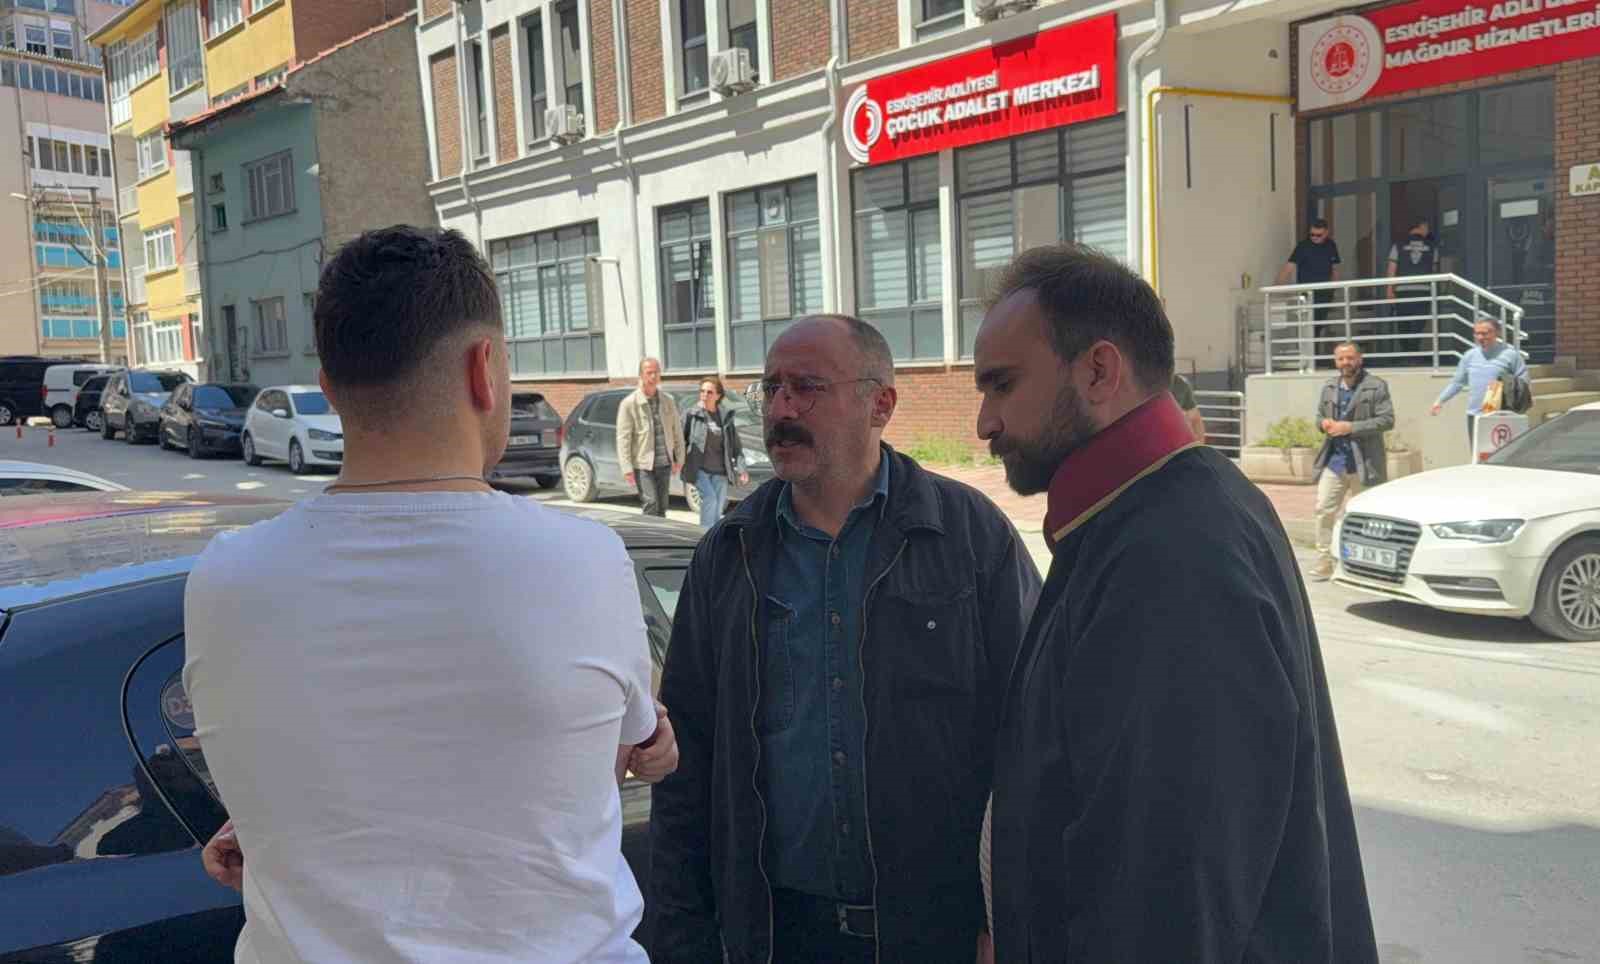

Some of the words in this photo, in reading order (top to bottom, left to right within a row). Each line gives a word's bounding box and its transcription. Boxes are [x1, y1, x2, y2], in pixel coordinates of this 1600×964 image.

[1385, 6, 1488, 43] ESKİŞEHİR
[1385, 38, 1473, 69] MAĞDUR
[886, 110, 943, 139] ÇOCUK
[944, 91, 1009, 121] ADALET
[1013, 64, 1100, 106] MERKEZİ
[887, 86, 943, 114] ESKİŞEHİR
[944, 70, 999, 98] ADLİYESİ
